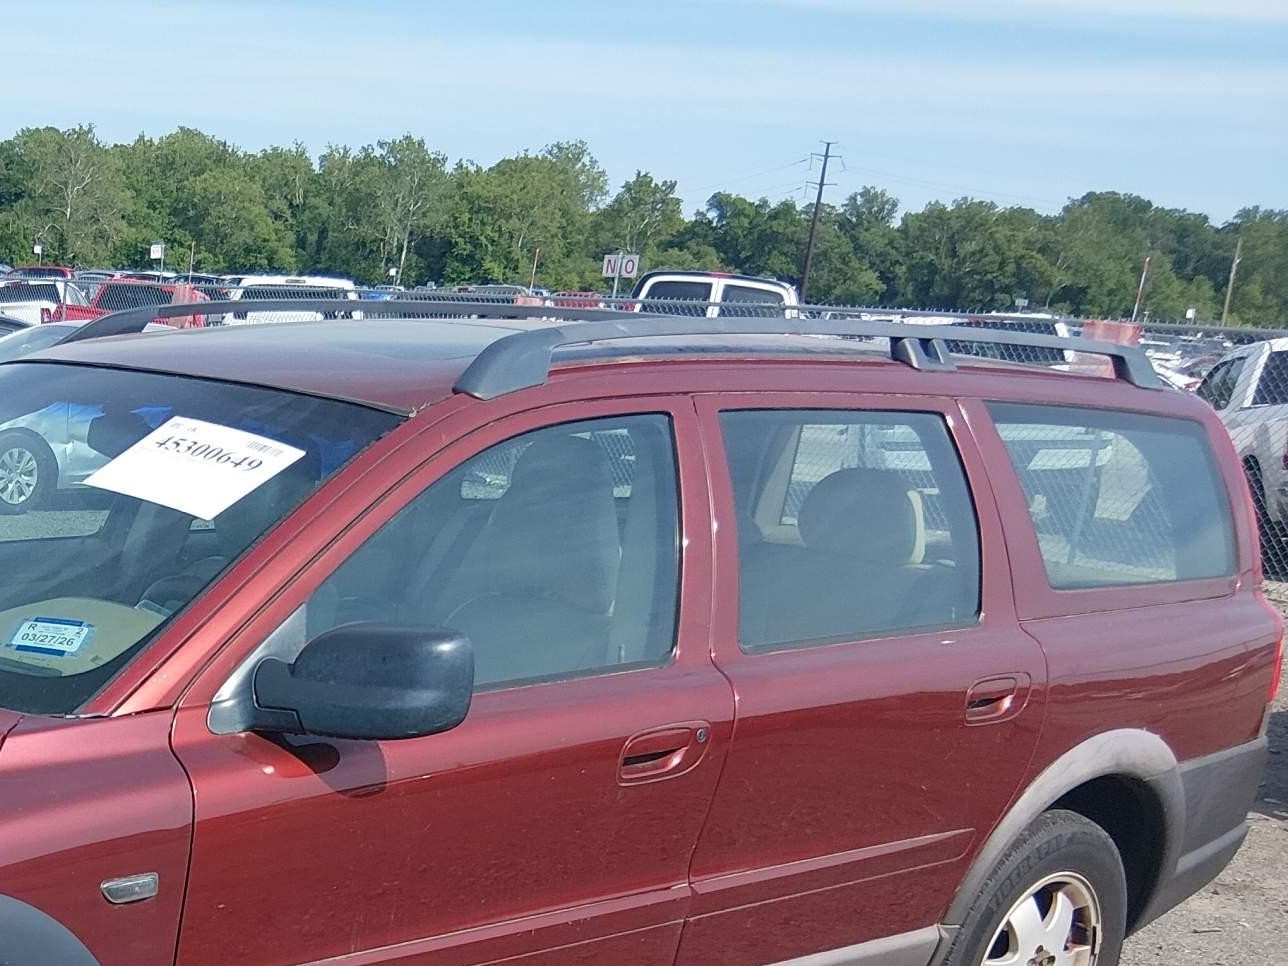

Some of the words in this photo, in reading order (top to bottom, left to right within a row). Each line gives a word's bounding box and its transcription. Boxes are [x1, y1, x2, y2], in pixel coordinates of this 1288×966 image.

[155, 435, 264, 472] 45300649
[27, 622, 38, 631] R
[20, 632, 76, 647] 03/27/26
